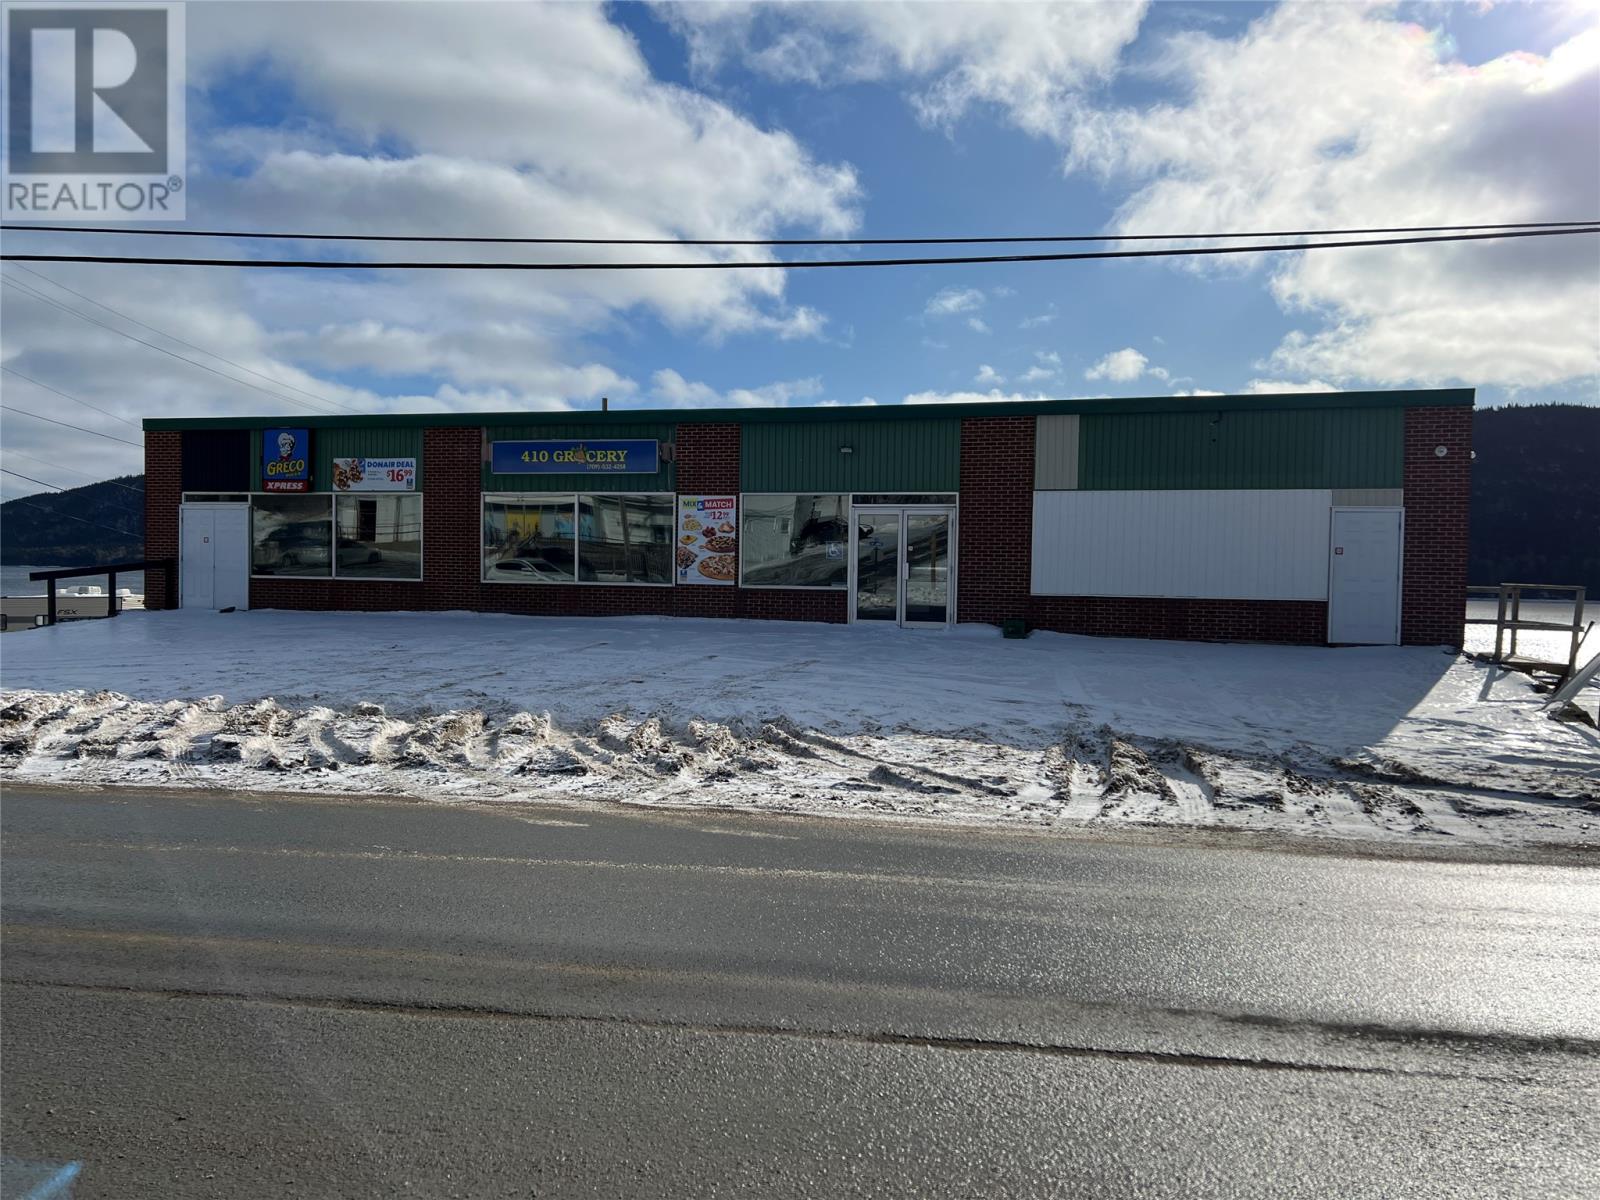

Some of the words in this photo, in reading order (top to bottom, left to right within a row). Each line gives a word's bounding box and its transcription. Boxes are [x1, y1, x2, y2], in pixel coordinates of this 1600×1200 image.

[521, 450, 549, 462] 410
[553, 450, 627, 463] GRCERY
[267, 459, 305, 476] GRECO
[267, 481, 304, 490] XPRESS
